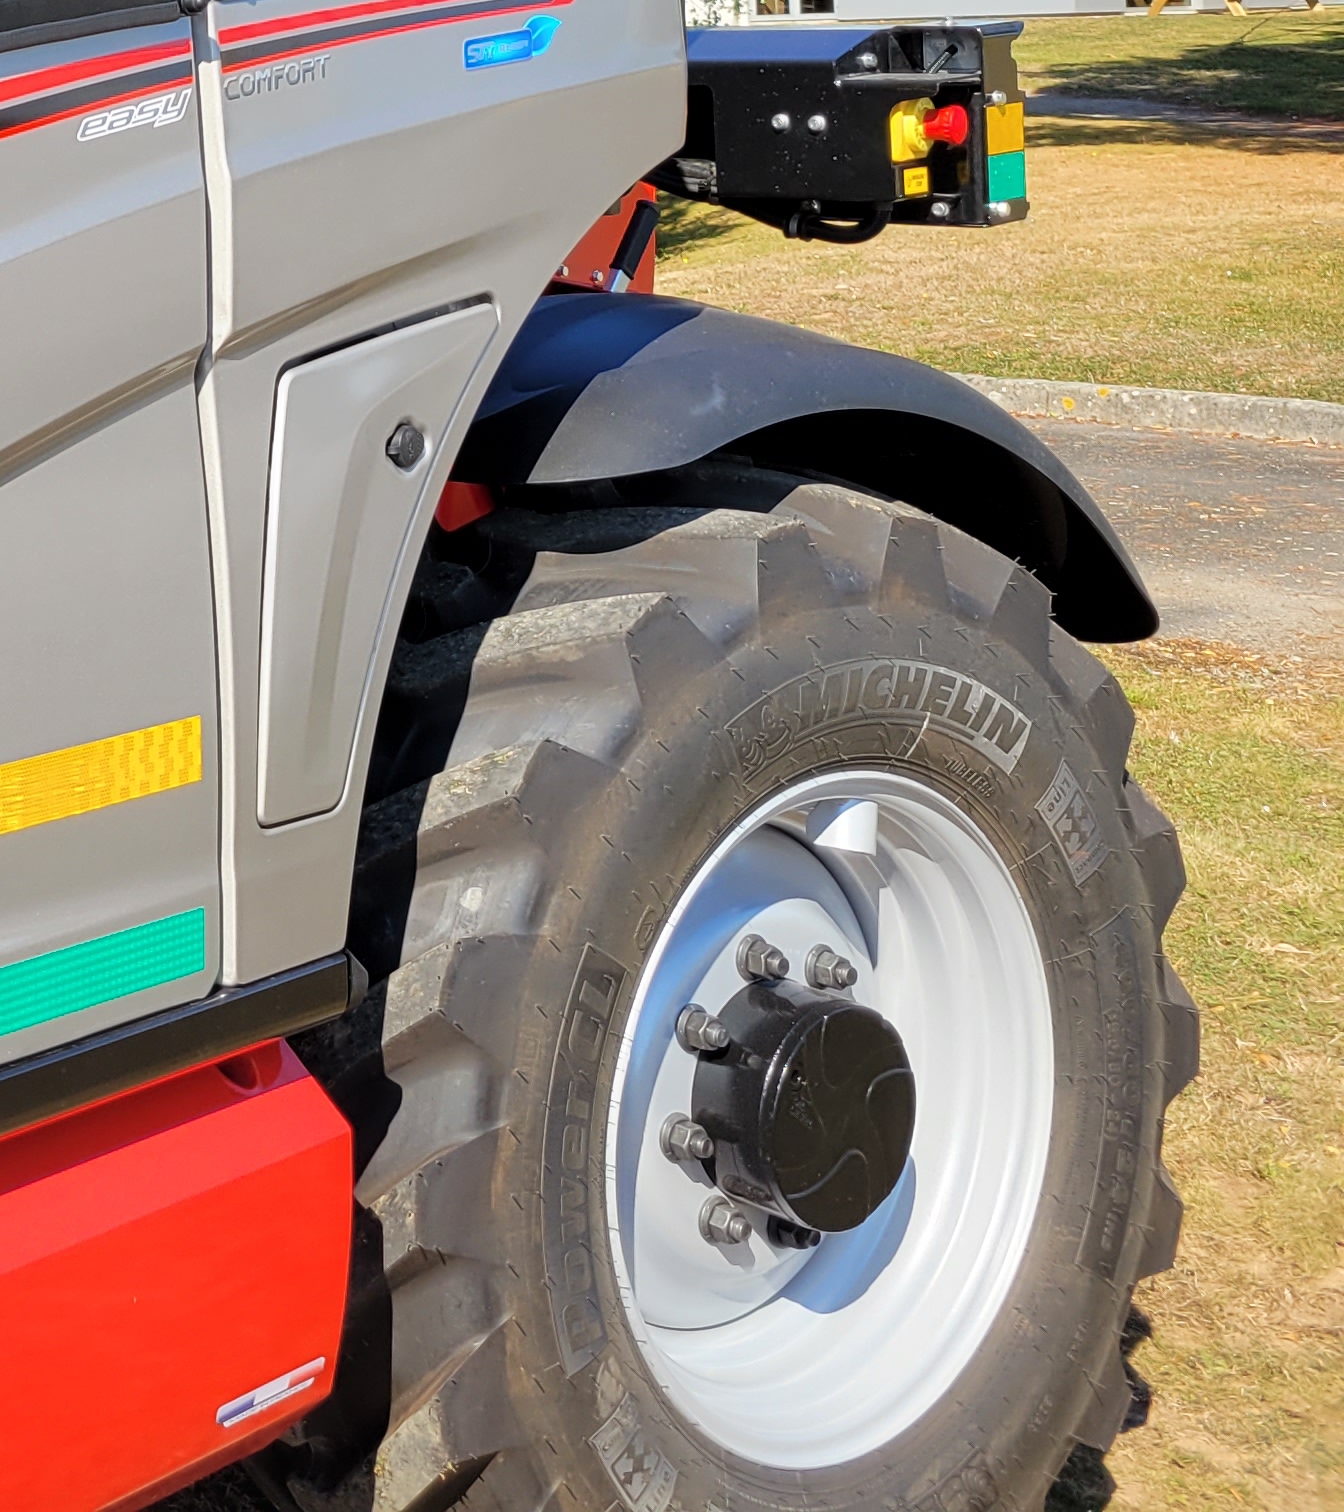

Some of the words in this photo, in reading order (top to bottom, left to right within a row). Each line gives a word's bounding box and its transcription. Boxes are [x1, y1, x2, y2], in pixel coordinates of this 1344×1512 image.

[223, 55, 331, 100] COMFORT
[77, 88, 192, 141] easy
[798, 664, 1029, 756] MICHELIN
[559, 1080, 607, 1356] Power
